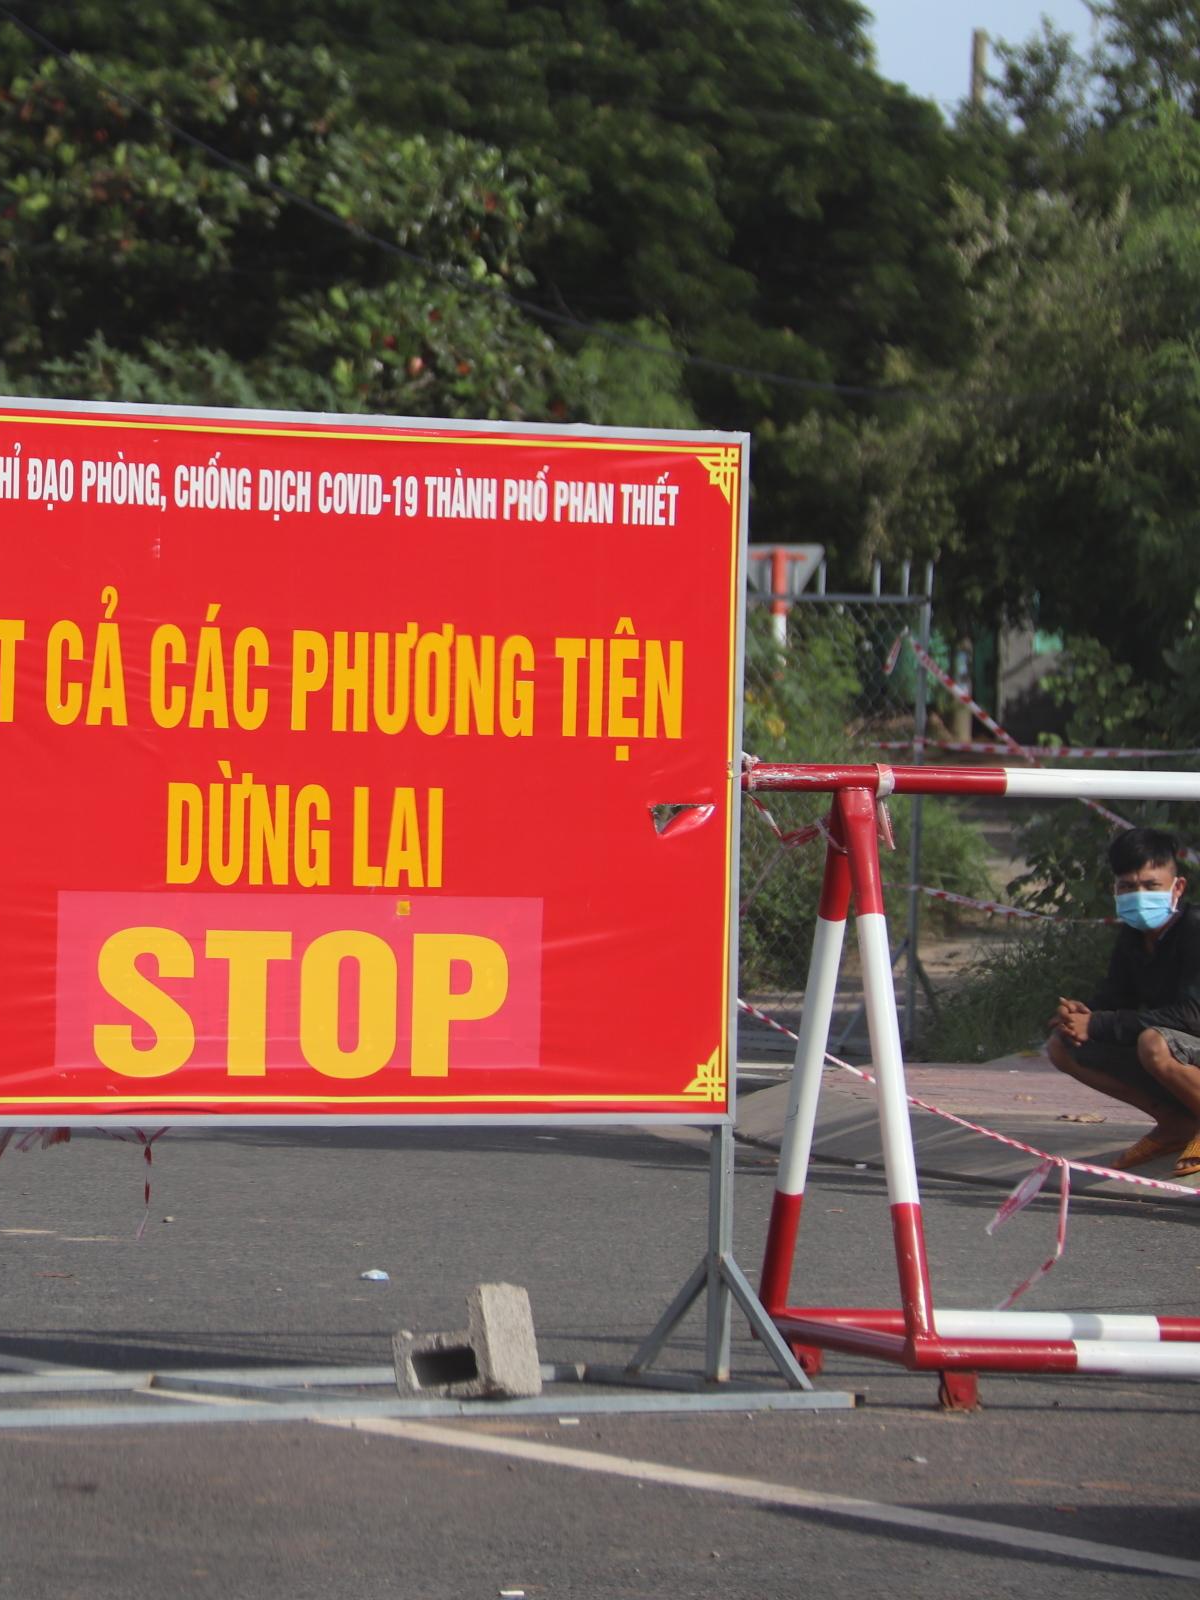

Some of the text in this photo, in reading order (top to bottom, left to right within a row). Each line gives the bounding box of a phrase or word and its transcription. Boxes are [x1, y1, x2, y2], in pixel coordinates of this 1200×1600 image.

[27, 458, 74, 511] ĐẠO
[81, 451, 167, 512] PHÒNG,
[174, 451, 252, 511] CHỐNG
[258, 469, 312, 521] DỊCH
[318, 471, 418, 517] COVID-19
[424, 468, 497, 520] THÀNH
[503, 465, 550, 522] PHỐ
[554, 480, 614, 524] PHAN
[620, 471, 680, 526] THIẾT
[45, 586, 129, 726] CẢ
[150, 603, 270, 731] CÁC
[290, 622, 535, 738] PHƯƠNG
[555, 616, 684, 761] TIỆN
[166, 760, 444, 916] DỪNG LẠI
[93, 926, 509, 1080] STOP
